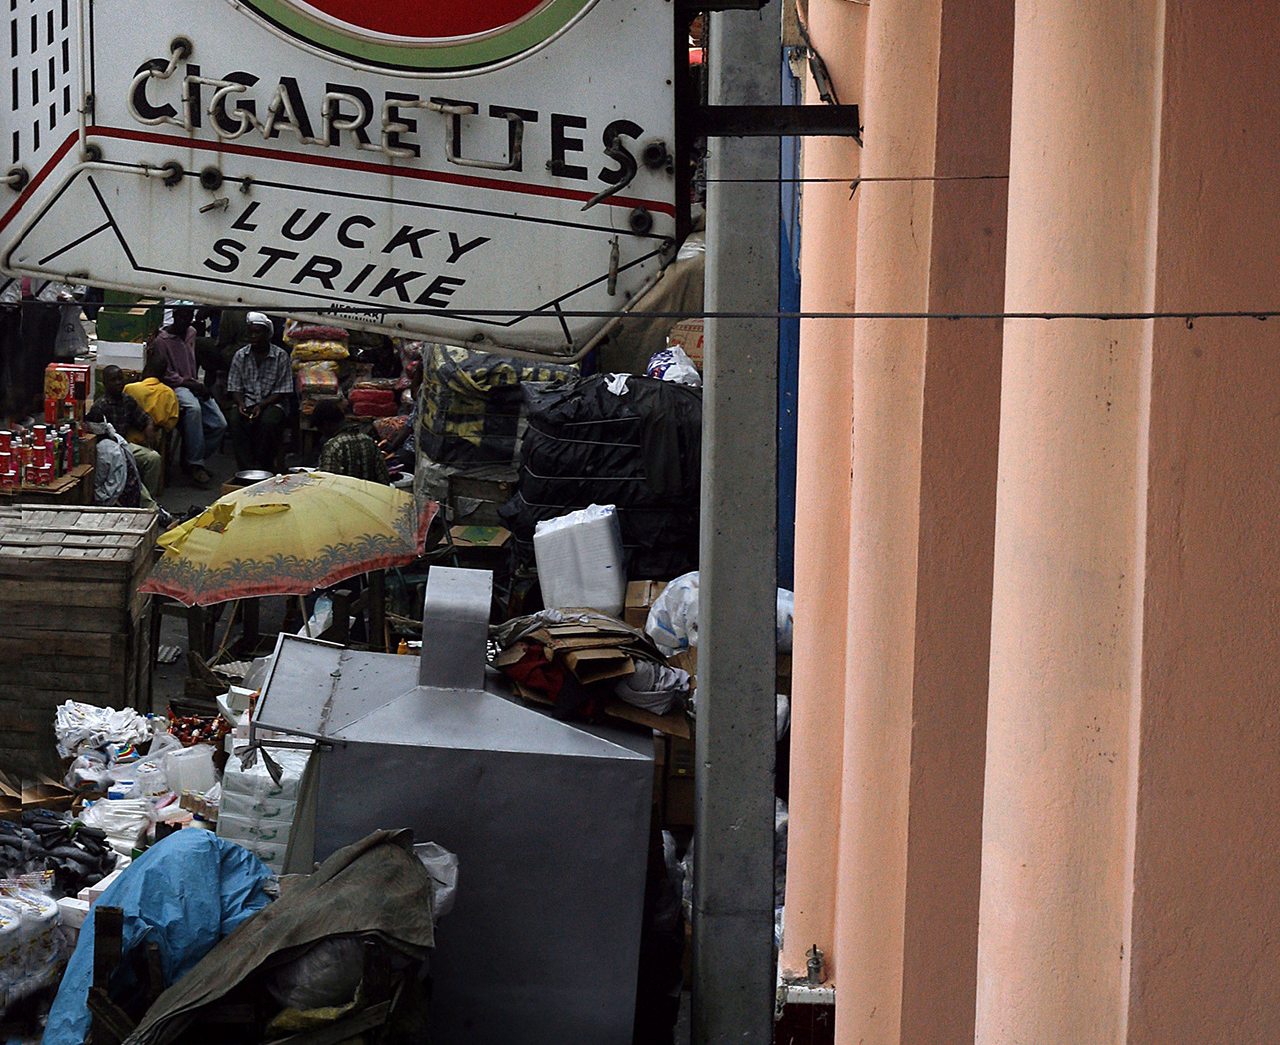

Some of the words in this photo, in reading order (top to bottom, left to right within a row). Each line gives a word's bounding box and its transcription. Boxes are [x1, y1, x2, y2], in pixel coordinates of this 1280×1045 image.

[128, 57, 645, 185] CIGARETTES
[231, 200, 491, 266] LUCKY
[203, 237, 467, 309] STRIKE
